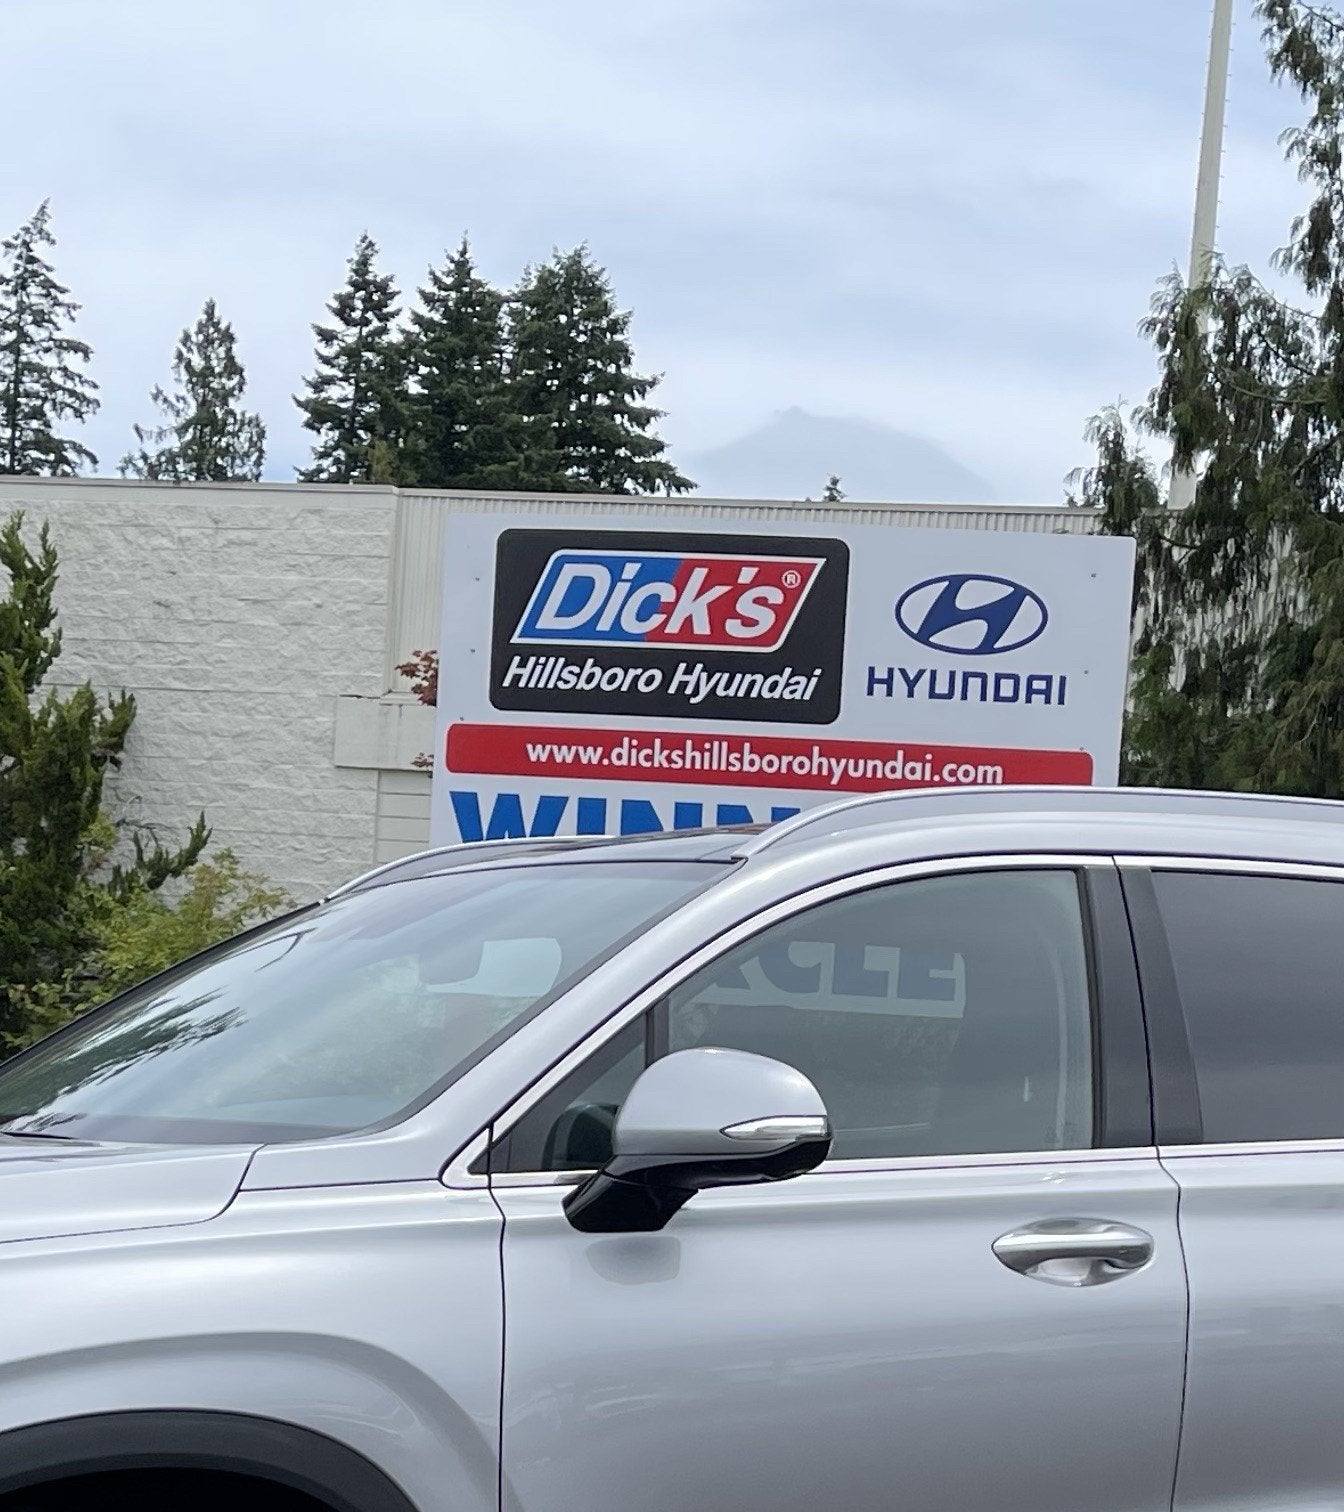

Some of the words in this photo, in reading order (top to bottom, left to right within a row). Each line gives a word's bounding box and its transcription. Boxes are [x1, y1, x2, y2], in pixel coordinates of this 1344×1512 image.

[535, 562, 784, 639] Dick's
[502, 655, 663, 693] Hillsboro
[667, 662, 823, 704] Hyundai
[866, 666, 1067, 706] HYUNDAI
[526, 737, 1005, 786] www.dickshillsborohyundai.com
